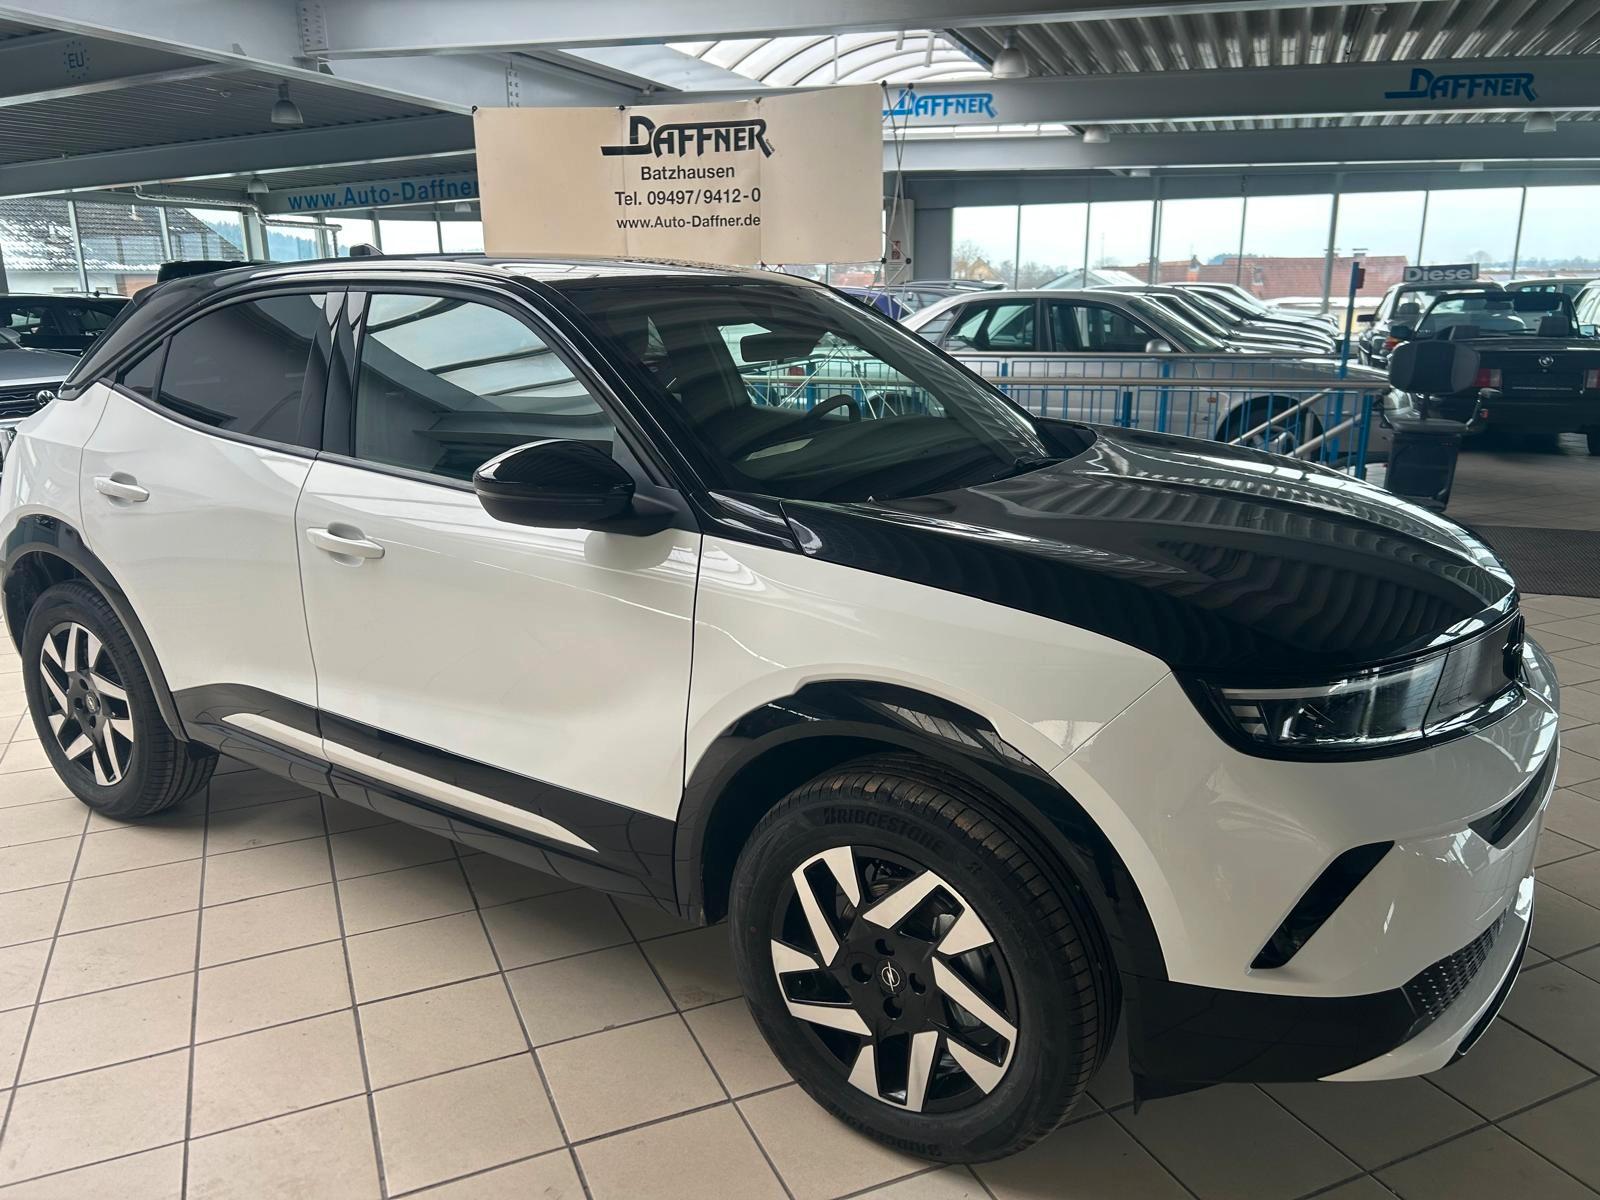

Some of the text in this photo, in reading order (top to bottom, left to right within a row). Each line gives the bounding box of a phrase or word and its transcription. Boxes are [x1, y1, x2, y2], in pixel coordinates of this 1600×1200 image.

[68, 52, 85, 68] EU
[1384, 68, 1537, 102] DAFFNER
[601, 116, 772, 158] DAFFNER
[641, 165, 735, 181] Batzhausen
[615, 187, 761, 206] Tel. 09497/9412-0
[616, 214, 761, 229] www.Auto-Daffner.de
[1405, 266, 1478, 281] Diesel
[823, 807, 946, 851] BRIDGESTONE
